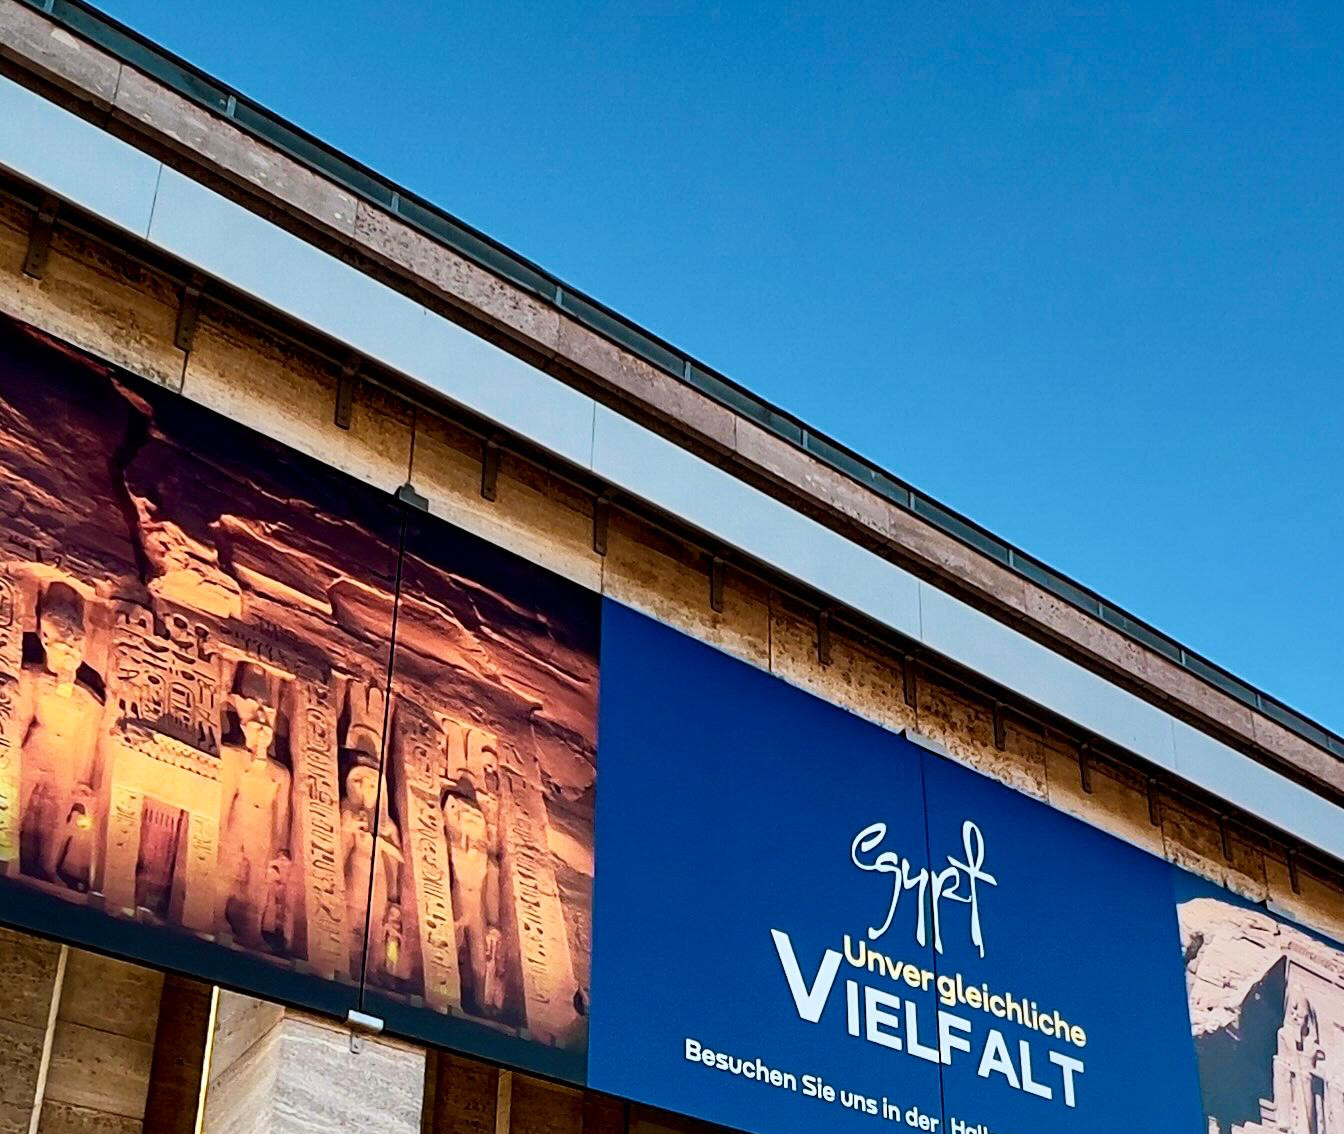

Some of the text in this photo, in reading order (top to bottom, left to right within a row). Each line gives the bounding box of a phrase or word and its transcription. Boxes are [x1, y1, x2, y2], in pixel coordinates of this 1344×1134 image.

[771, 928, 1085, 1108] VIELFALT
[843, 934, 1087, 1047] Unvergleichliche
[685, 1038, 797, 1091] Besuchen
[802, 1074, 836, 1102] Sie
[840, 1090, 878, 1115] uns
[883, 1097, 901, 1122] in
[905, 1106, 939, 1133] der
